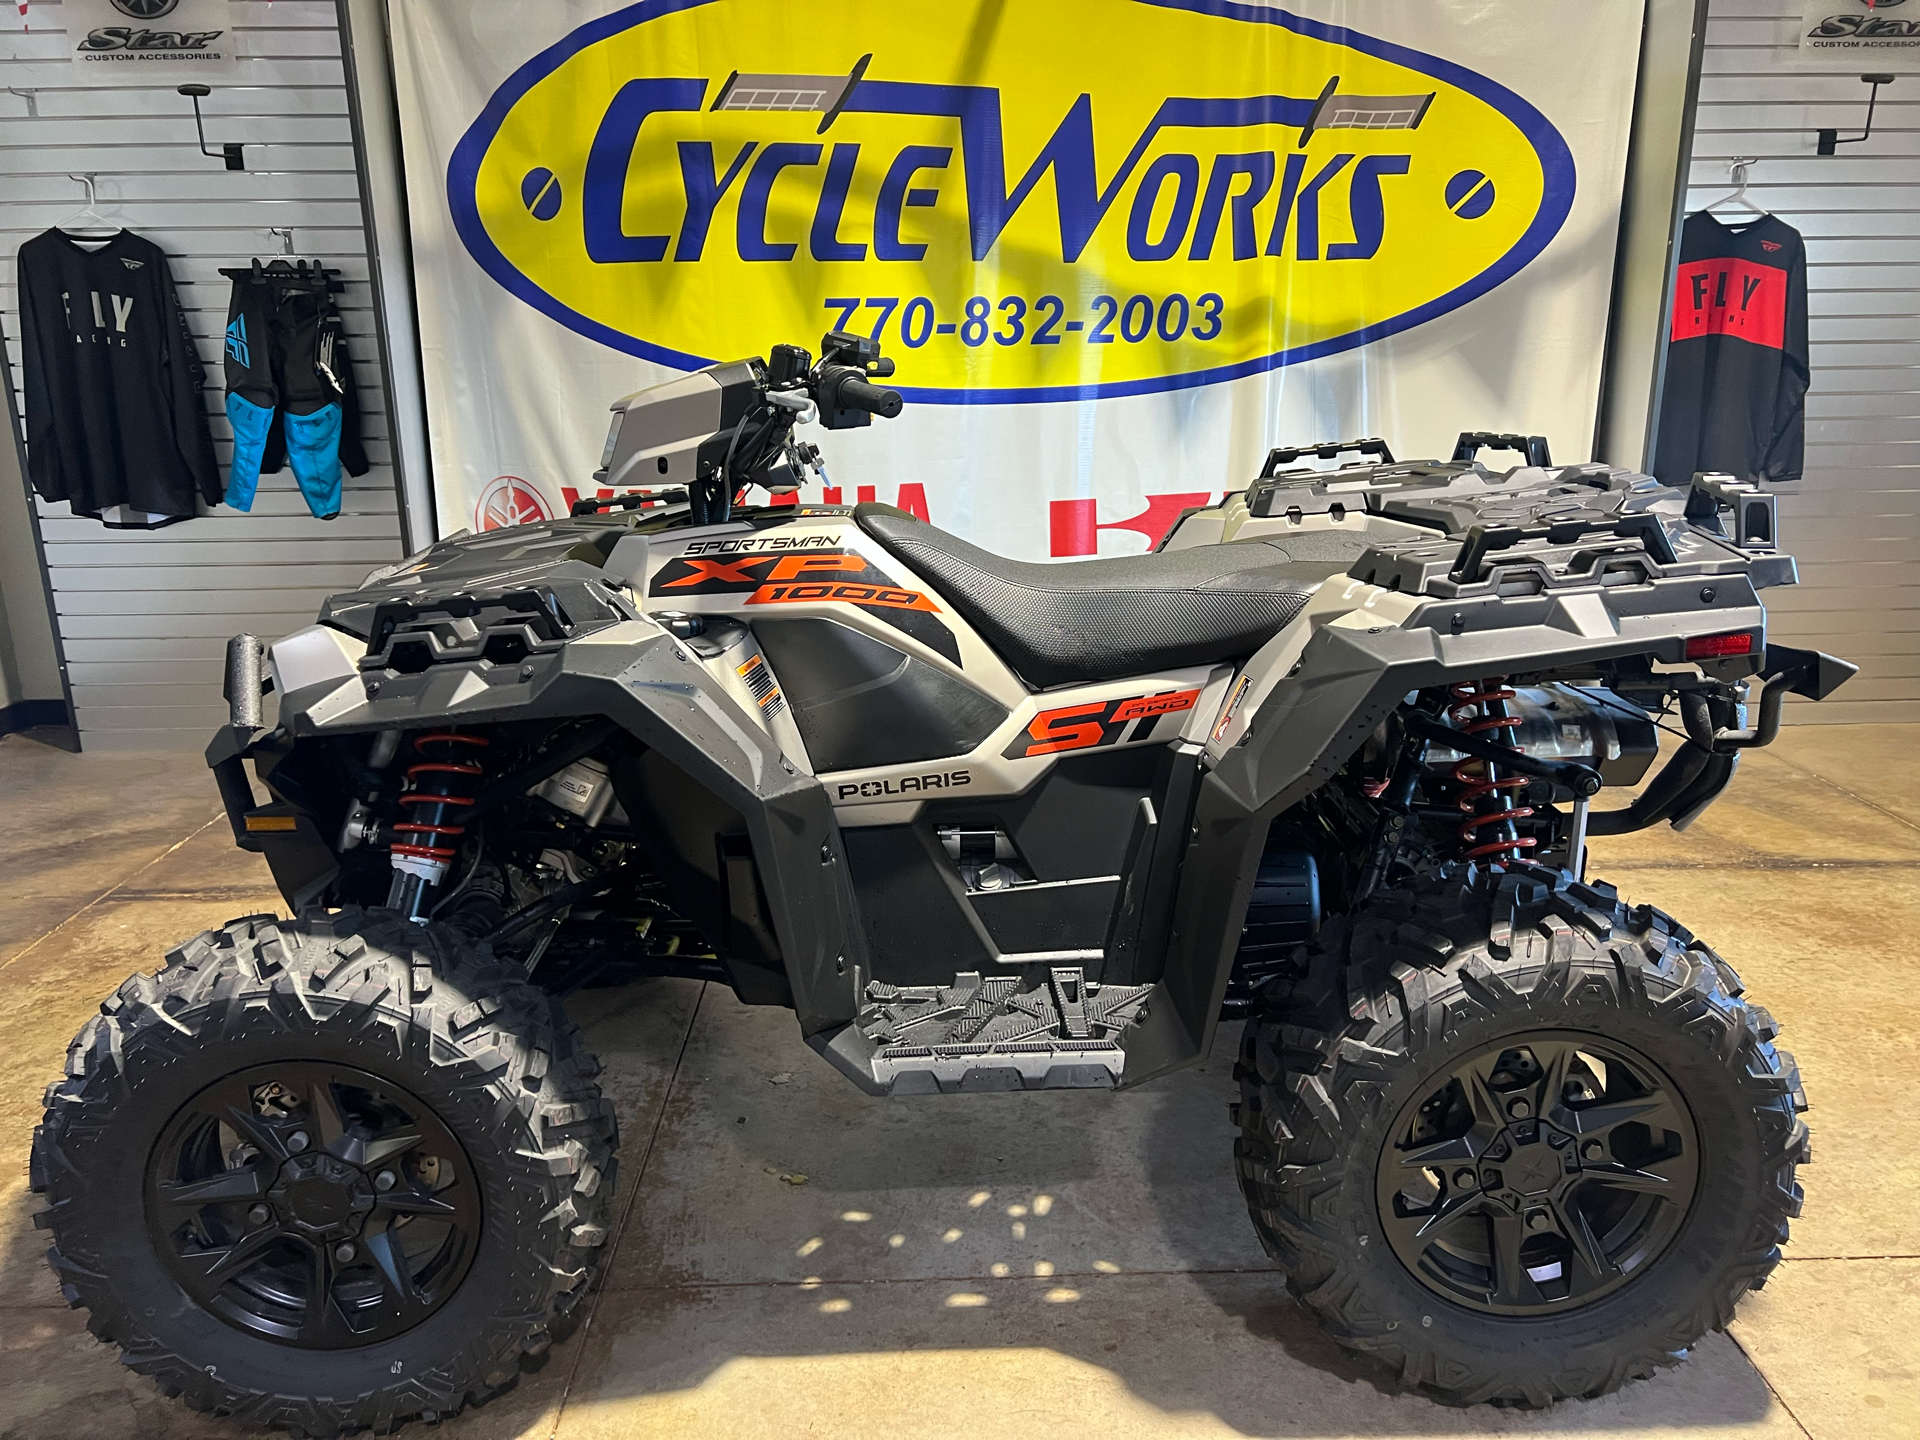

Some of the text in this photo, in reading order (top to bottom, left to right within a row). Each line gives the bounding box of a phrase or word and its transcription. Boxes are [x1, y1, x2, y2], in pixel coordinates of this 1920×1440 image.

[77, 27, 224, 51] Star
[85, 53, 221, 62] CUSTOM ACCESSORIES
[1690, 272, 1762, 312] FLY
[823, 293, 1224, 349] 770-832-2003
[683, 535, 842, 556] SPORTSMAN
[659, 554, 868, 588] XP
[769, 585, 920, 604] 1000
[1125, 699, 1190, 716] AWD
[837, 770, 972, 800] POLARIS
